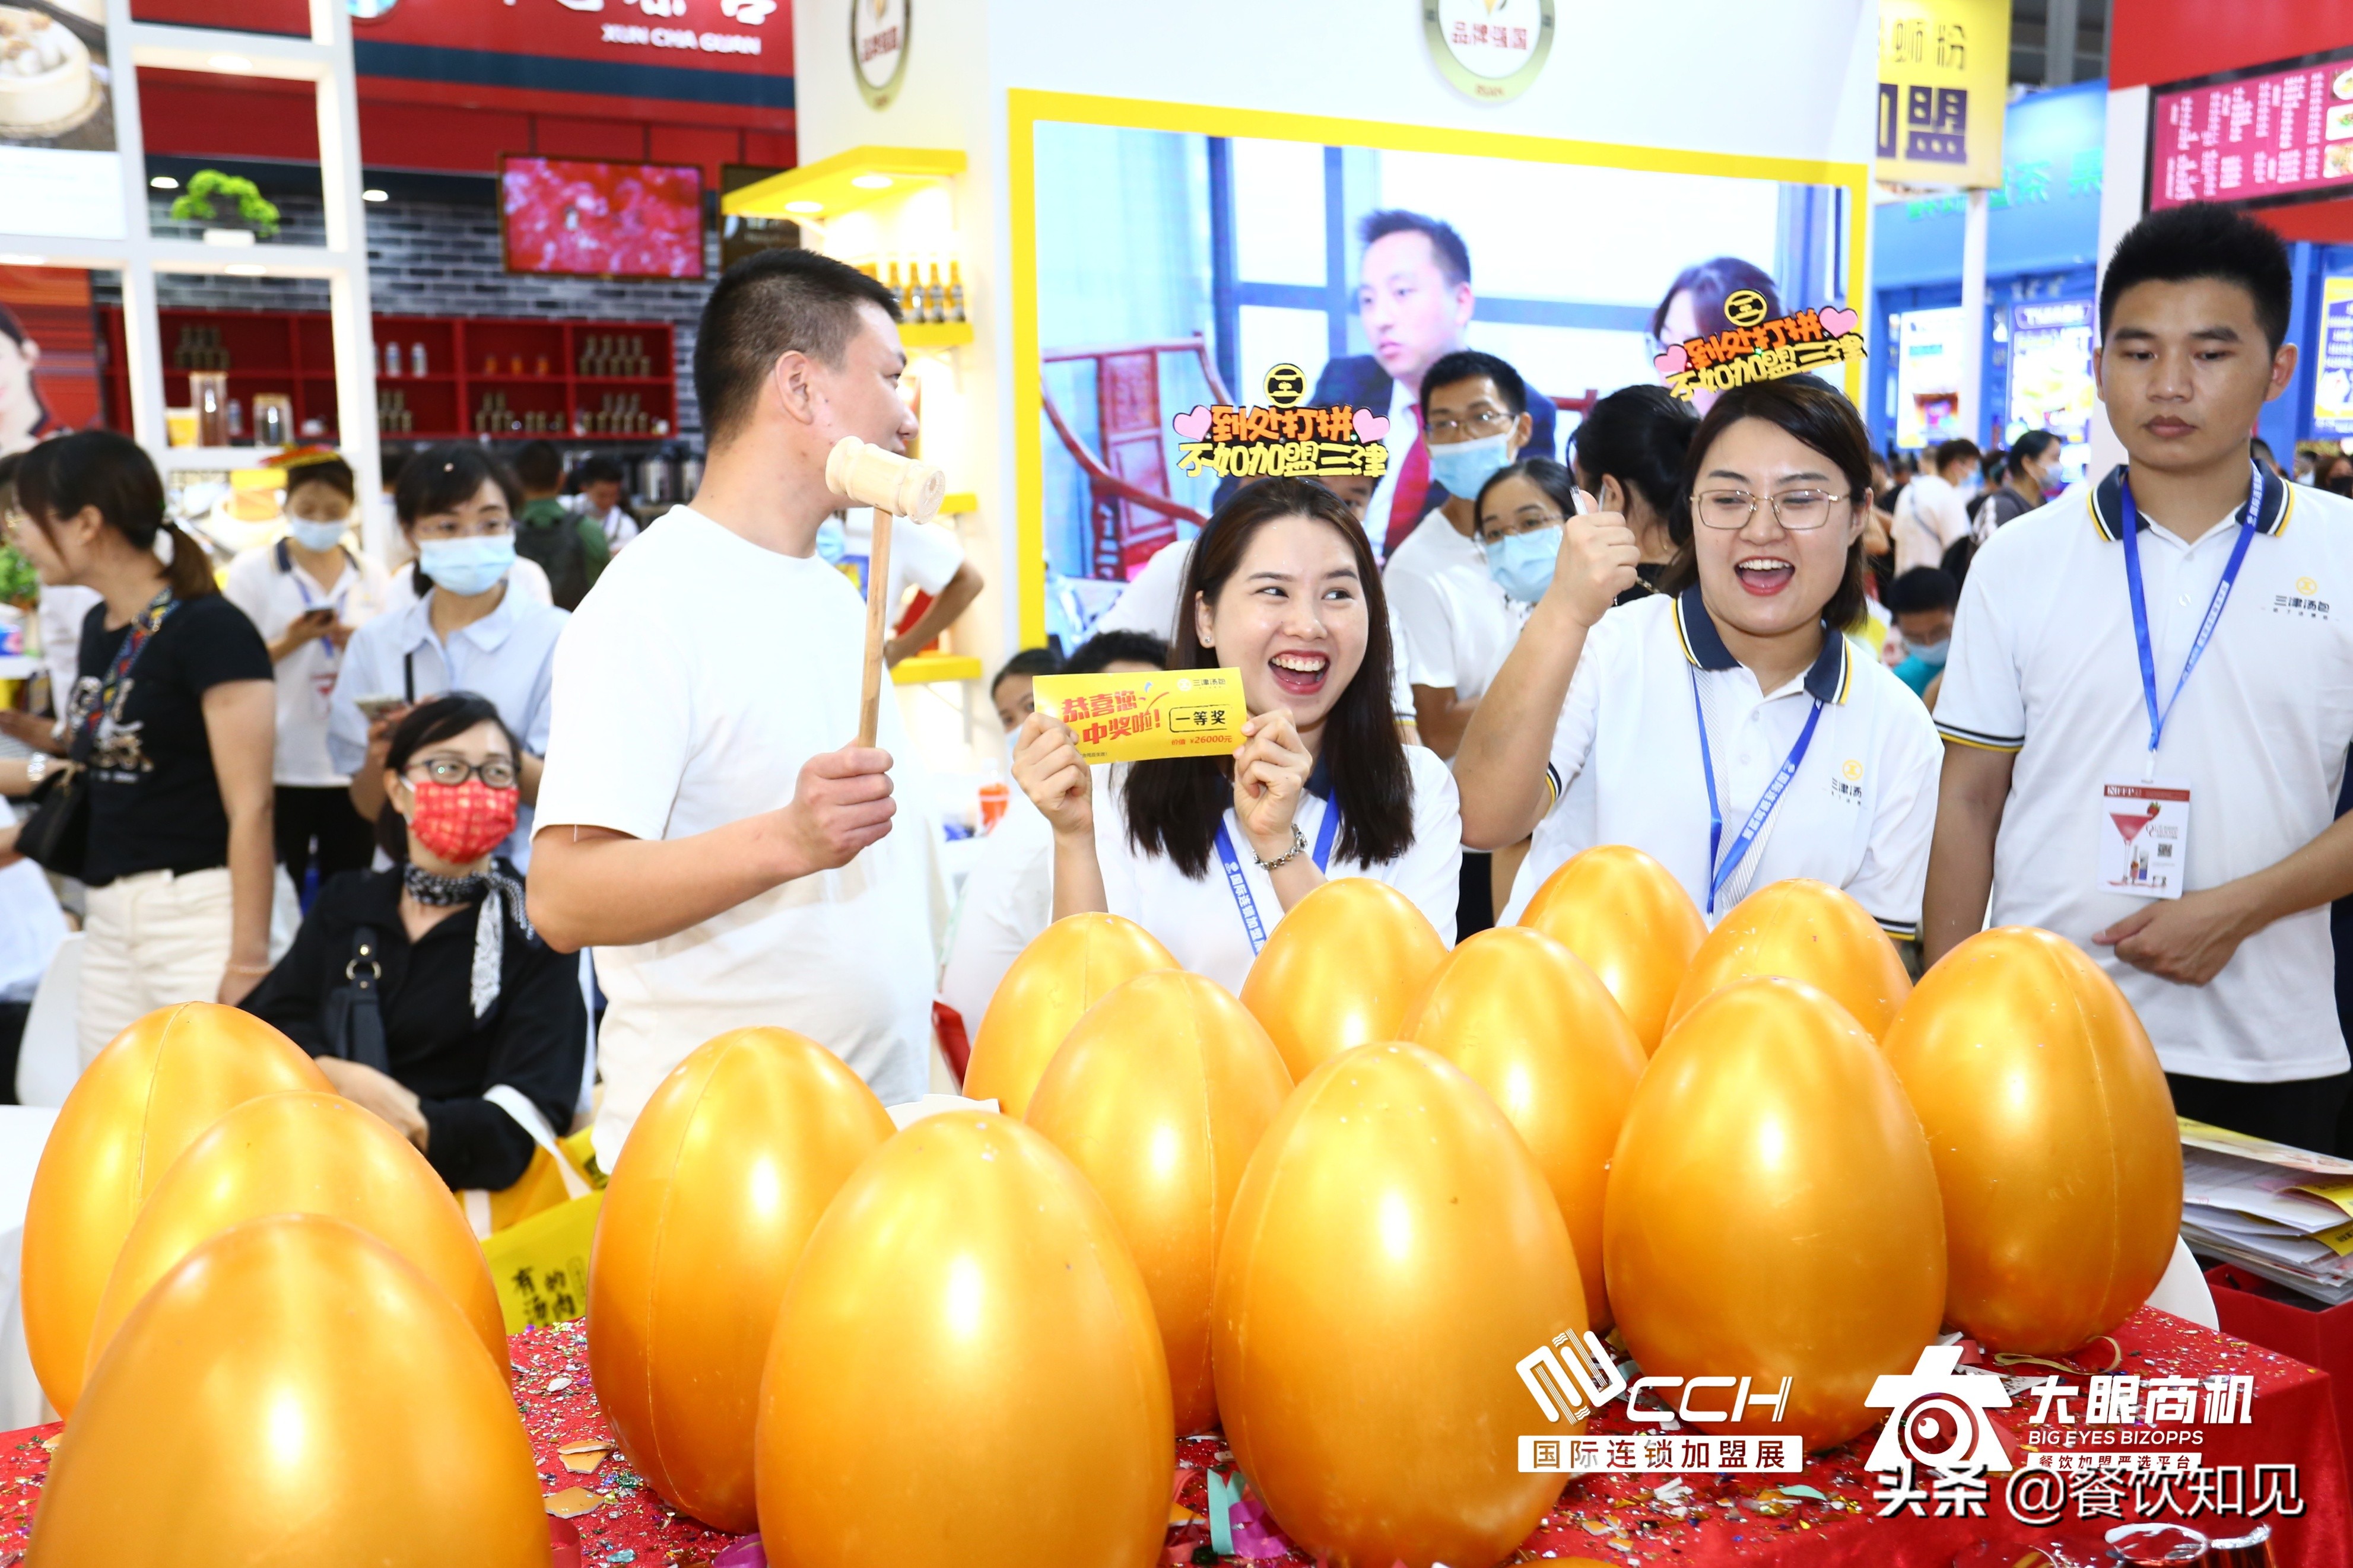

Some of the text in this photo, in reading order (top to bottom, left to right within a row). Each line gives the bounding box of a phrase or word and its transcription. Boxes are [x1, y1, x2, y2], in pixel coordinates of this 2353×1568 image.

[601, 23, 761, 55] XUN CHA GUAN
[1684, 308, 1824, 370] 到处打拼
[1666, 333, 1868, 402] 不如加盟三津
[1211, 405, 1353, 442] 到处打拼
[1177, 441, 1389, 478] 不如加盟三津
[1061, 690, 1138, 723] 恭喜您
[1176, 710, 1226, 726] 一等奖
[1083, 709, 1160, 745] 中奖啦!
